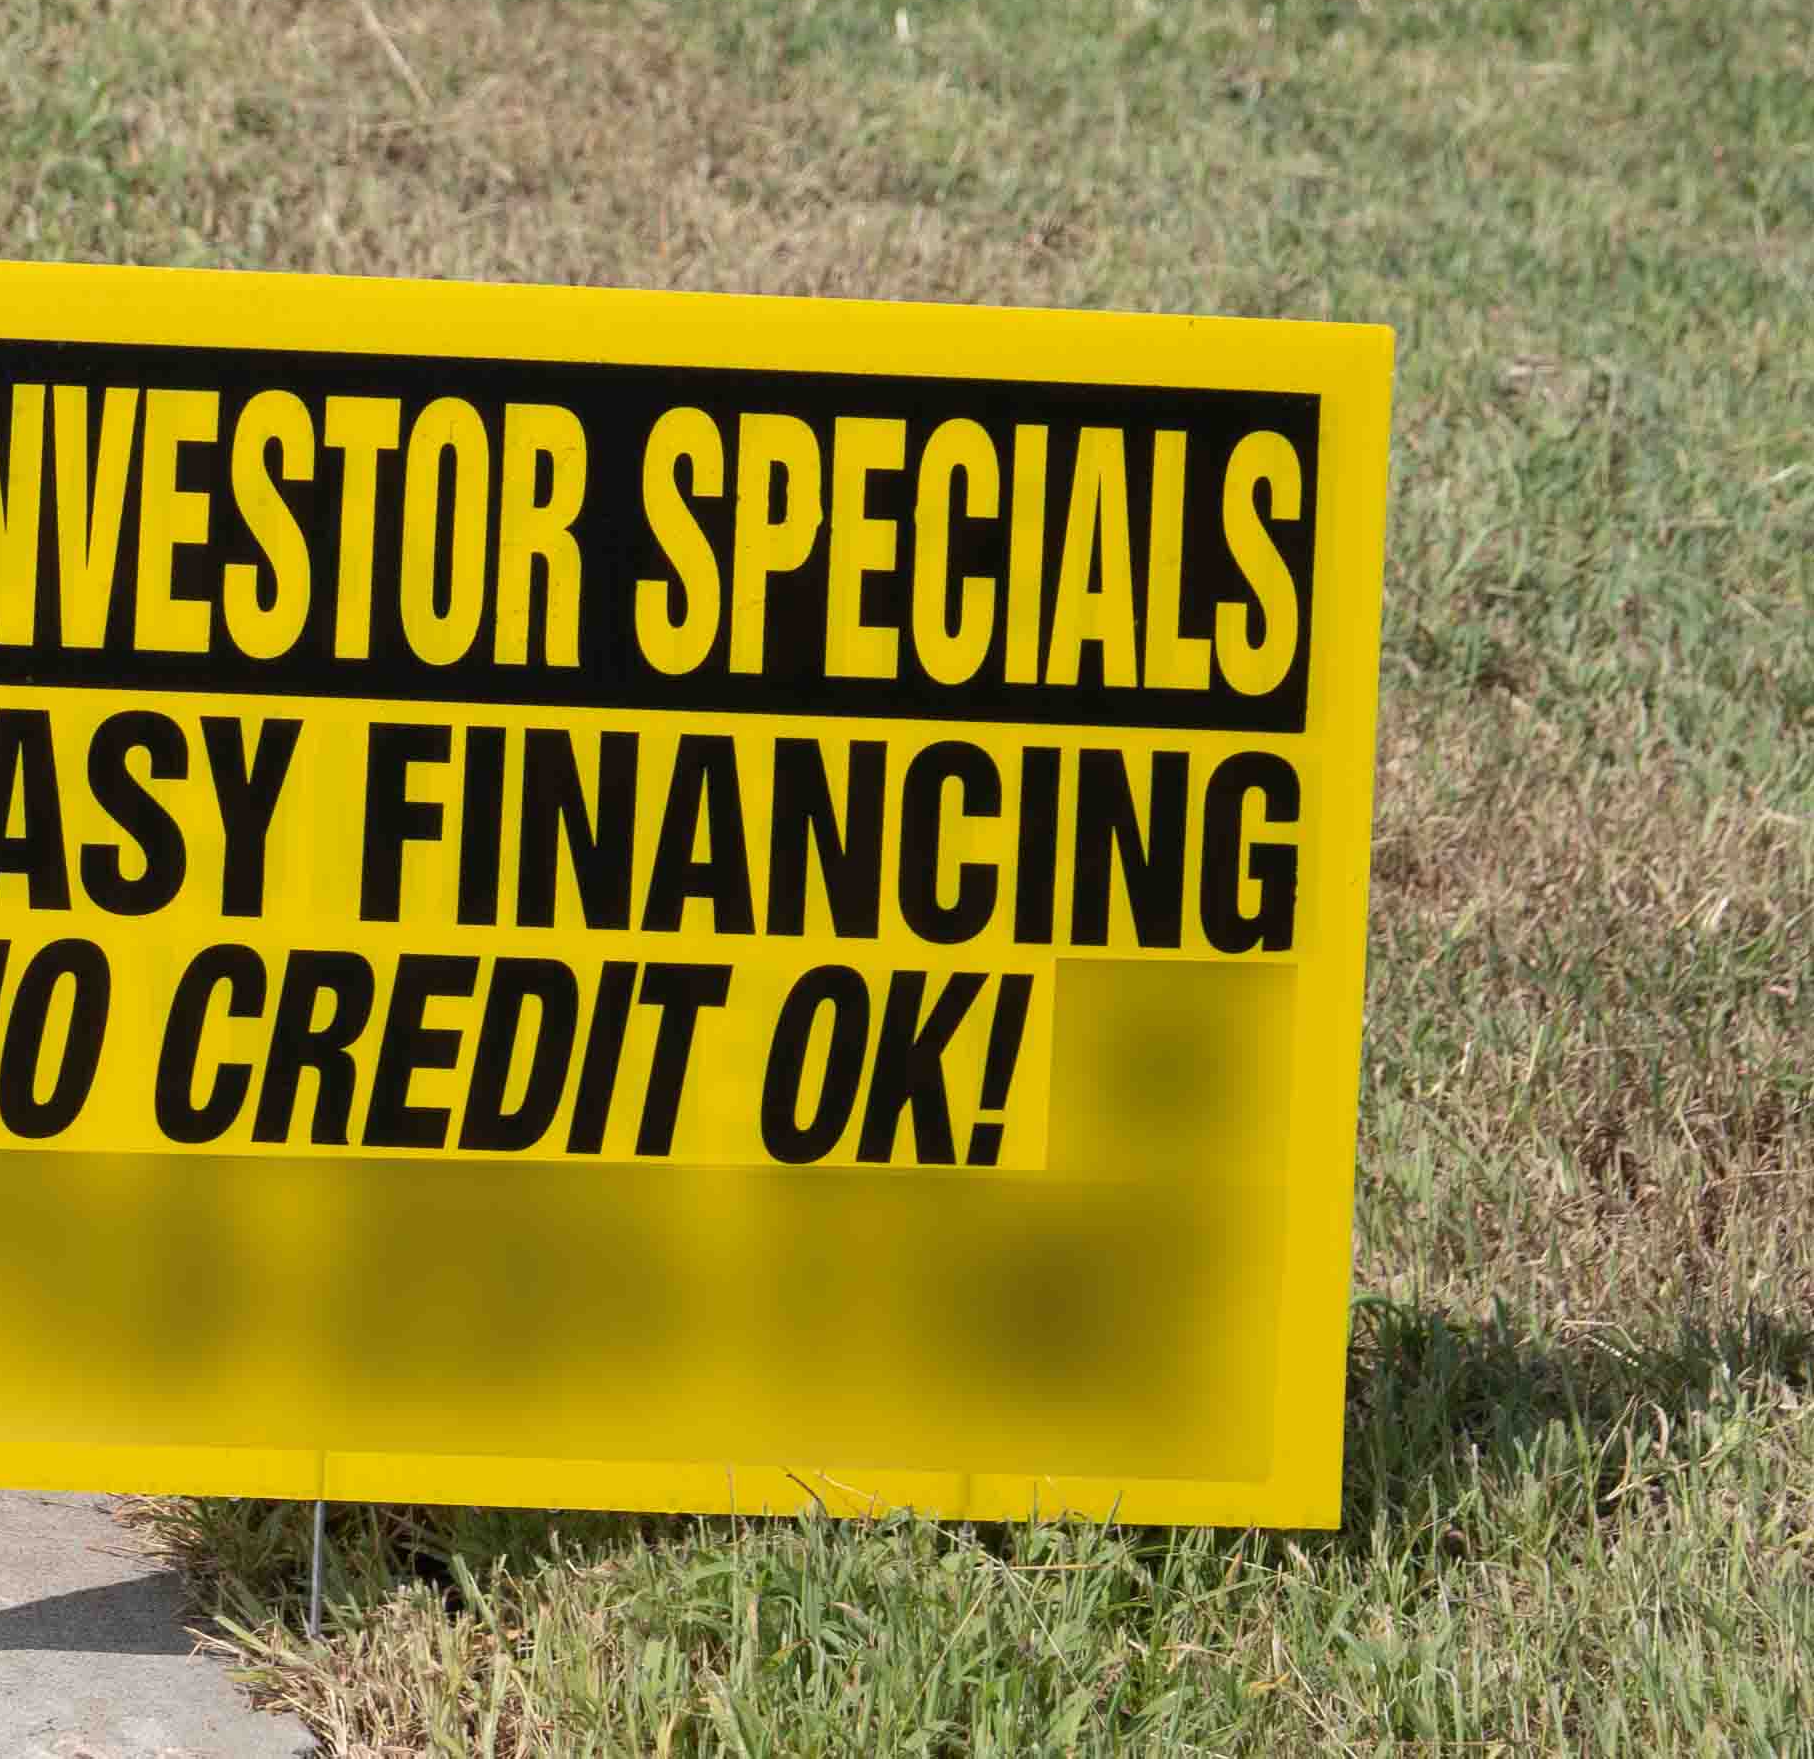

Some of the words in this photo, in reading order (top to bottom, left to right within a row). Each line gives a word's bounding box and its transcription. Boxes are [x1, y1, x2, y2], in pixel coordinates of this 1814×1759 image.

[634, 406, 1302, 696] SPECIALS
[359, 721, 1301, 955] FINANCING
[154, 943, 734, 1157] CREDIT
[760, 964, 1035, 1167] OK!
